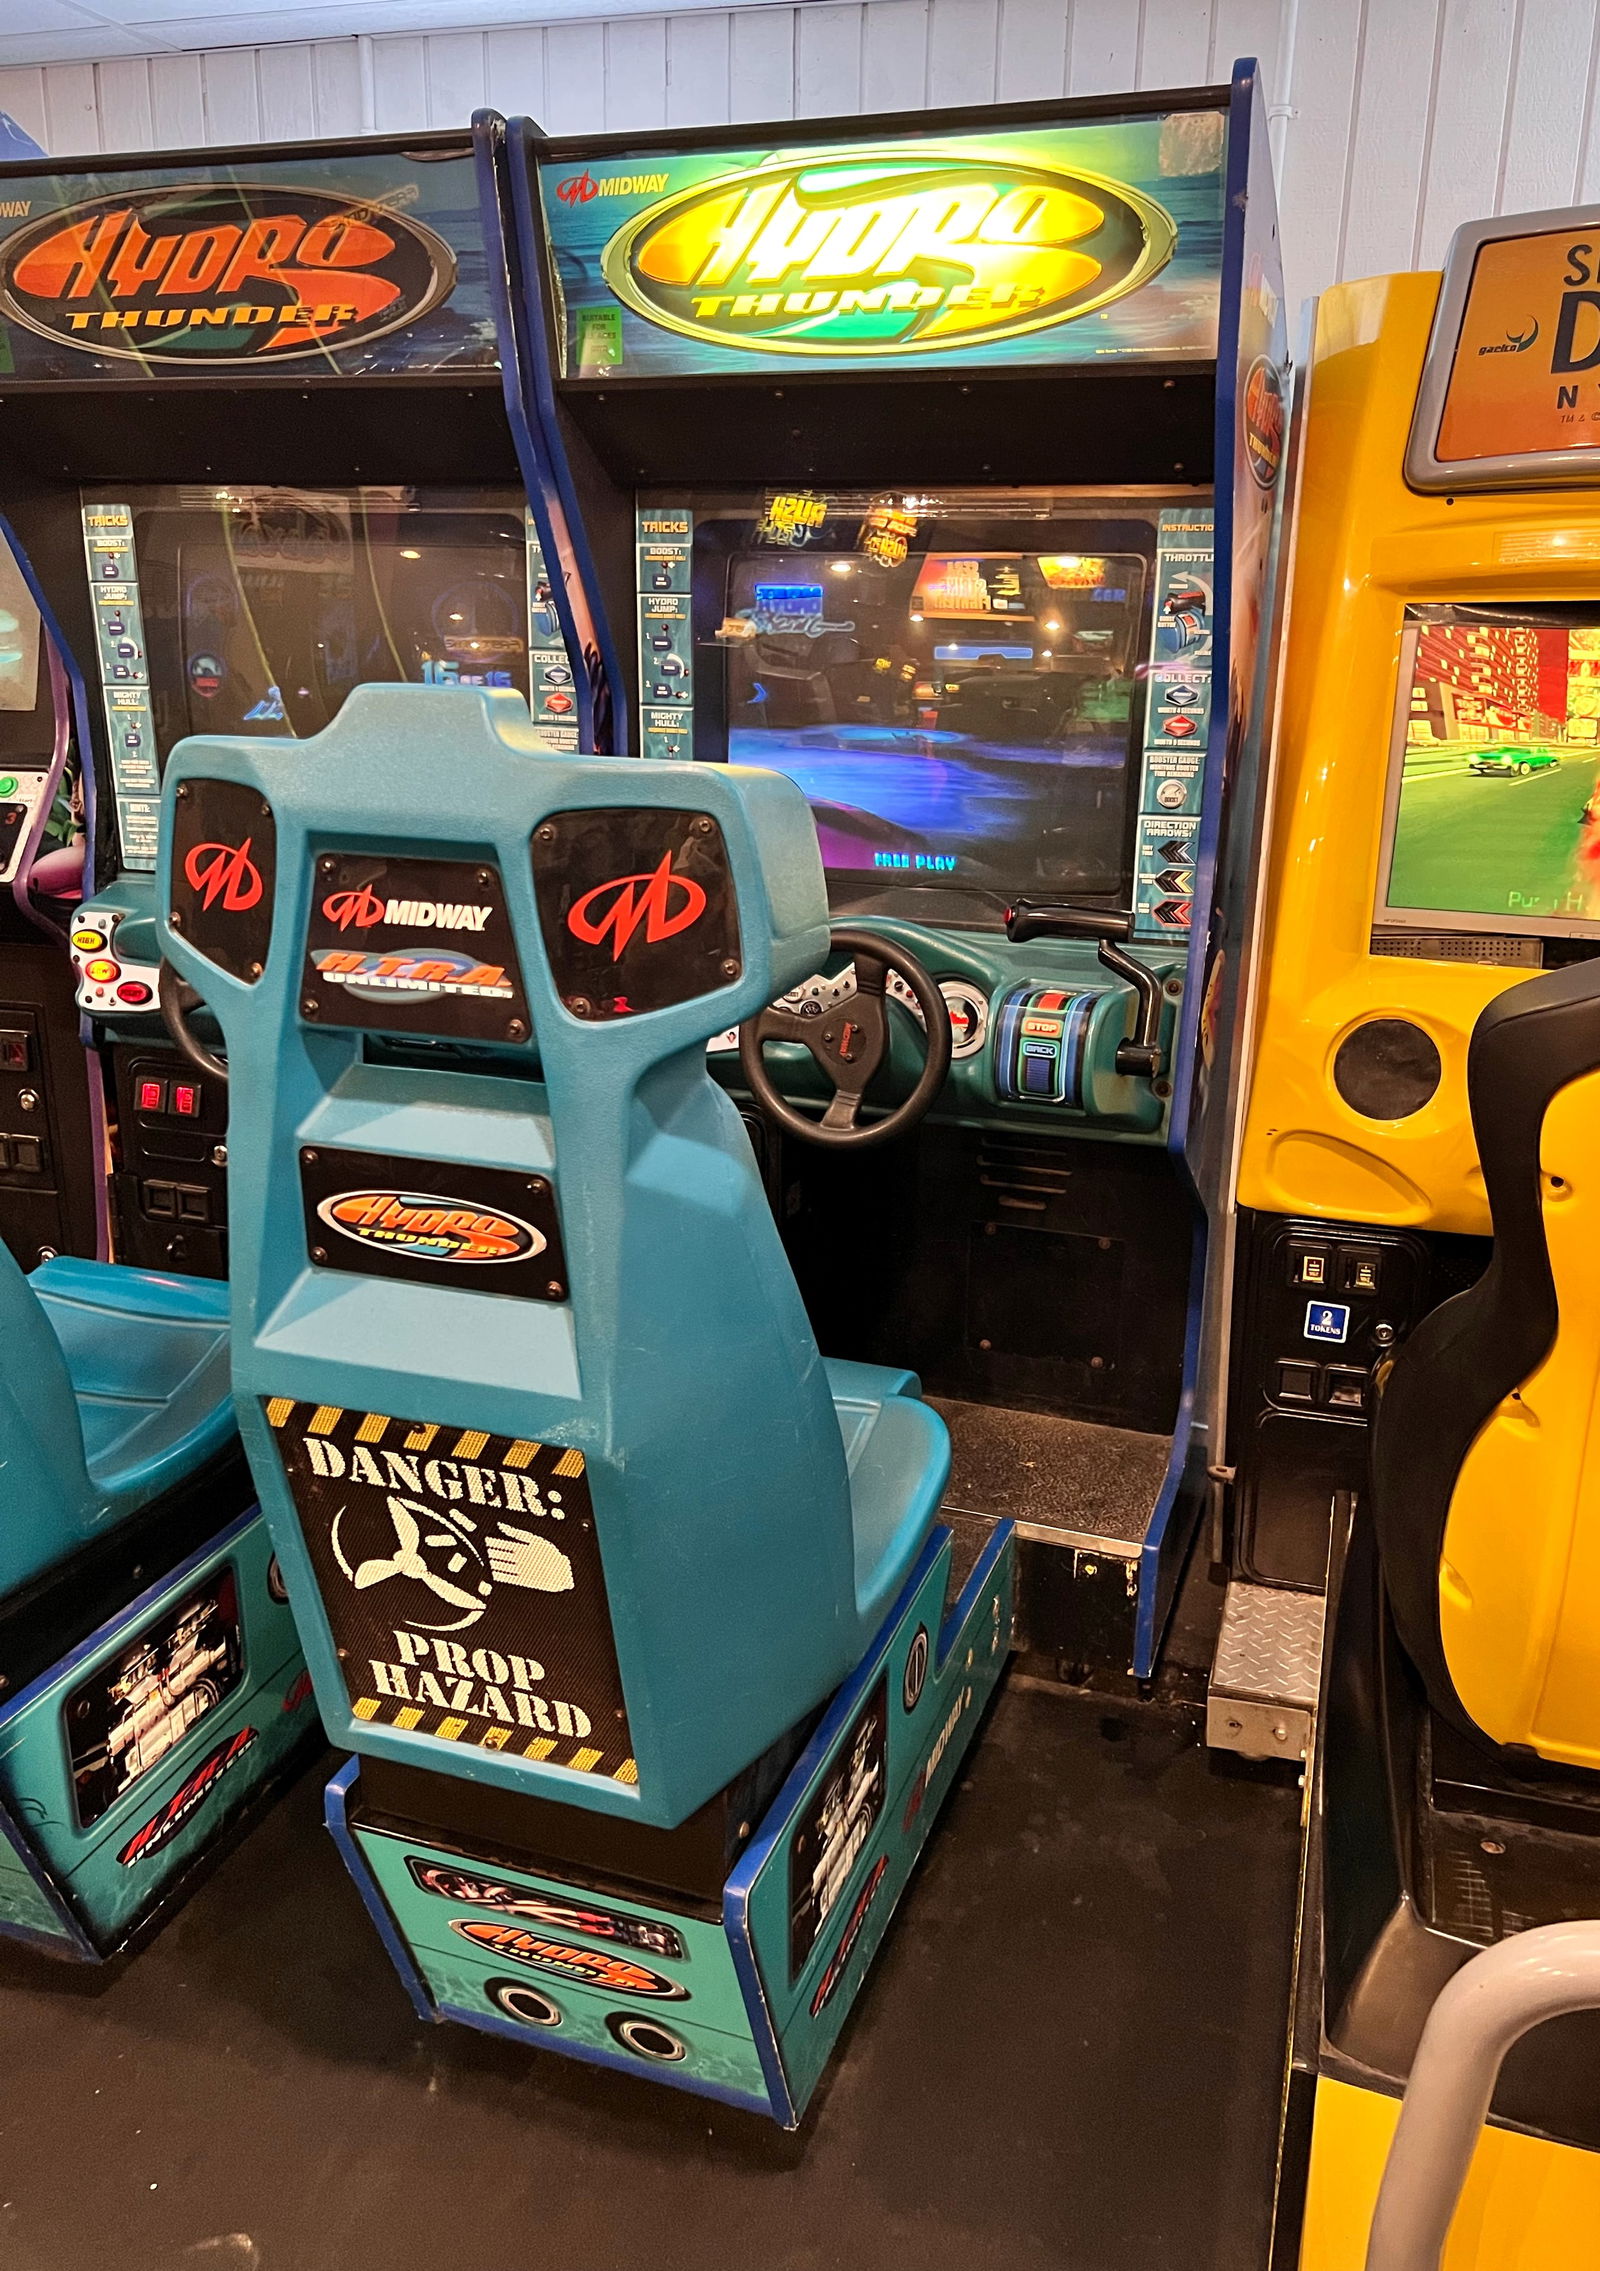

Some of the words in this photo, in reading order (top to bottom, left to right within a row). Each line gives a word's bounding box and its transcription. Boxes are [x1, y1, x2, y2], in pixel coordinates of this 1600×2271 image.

[597, 173, 669, 196] MIDWAY
[0, 201, 31, 217] WAY
[637, 176, 1104, 286] HYDRO
[13, 209, 401, 300] HYDRO
[1563, 244, 1600, 287] S
[690, 282, 1044, 319] THUNDER
[65, 303, 358, 330] THUNDER
[1478, 343, 1517, 356] gaelco
[87, 515, 129, 528] TRICKS
[642, 521, 689, 534] TRICKS
[650, 547, 682, 555] BOOST:
[648, 597, 679, 605] HYDRO
[651, 605, 678, 613] JUMP:
[651, 711, 684, 721] MIGHTY
[654, 719, 680, 727] HULL:
[1143, 820, 1197, 829] DIRECTION
[915, 853, 956, 871] PLAY
[384, 899, 493, 931] MIDWAY
[322, 970, 514, 999] UNLIMITED
[1027, 1021, 1057, 1033] STOP
[1026, 1044, 1054, 1055] BACK
[331, 1196, 520, 1237] HYDRO
[356, 1227, 499, 1256] THUNDER
[1321, 1309, 1333, 1326] 2
[1309, 1323, 1342, 1336] TOKENS
[303, 1437, 565, 1520] DANGER:
[393, 1630, 546, 1692] PROP
[368, 1659, 592, 1739] HAZARD
[462, 1923, 656, 1980] HYDRO
